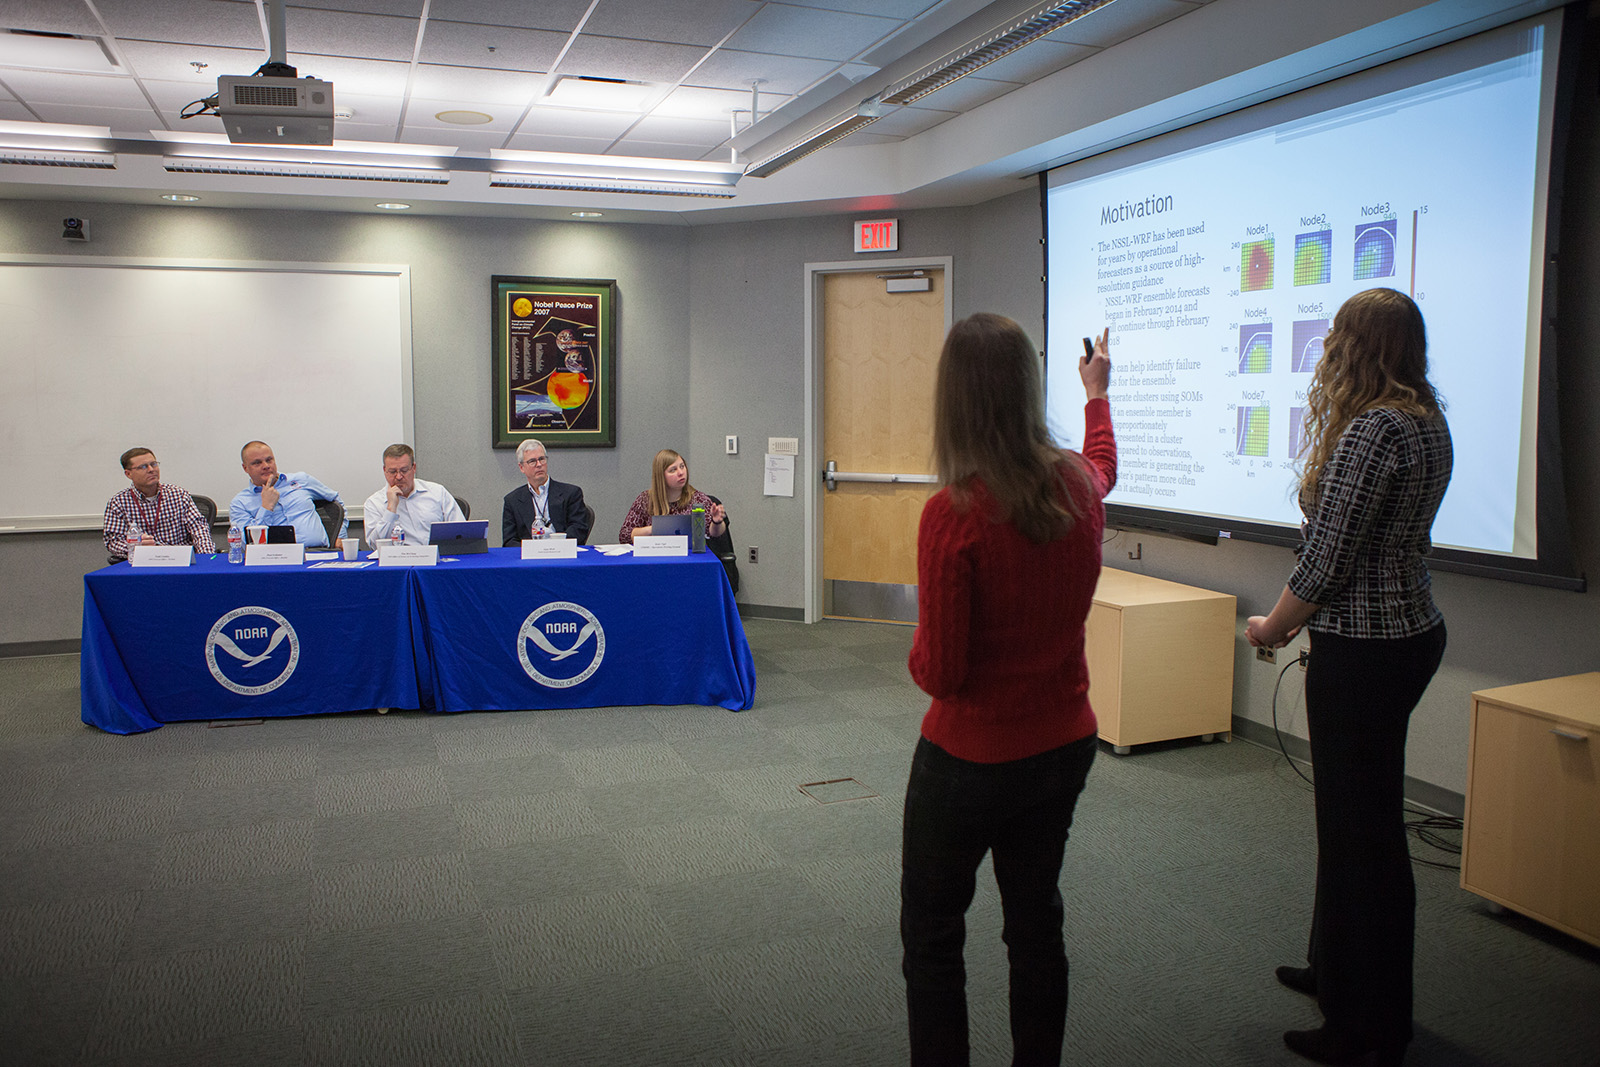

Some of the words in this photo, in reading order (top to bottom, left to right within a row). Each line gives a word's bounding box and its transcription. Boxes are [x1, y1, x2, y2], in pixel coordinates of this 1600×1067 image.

[1101, 194, 1173, 226] Motivation
[1361, 202, 1390, 216] Node3
[1420, 205, 1428, 214] 15
[1300, 214, 1326, 227] Node2
[861, 222, 892, 249] EXIT
[1098, 241, 1110, 252] The
[1112, 232, 1151, 250] NSSL-WRF
[1153, 231, 1166, 242] has
[1167, 228, 1185, 239] been
[1186, 221, 1205, 235] used
[1246, 224, 1268, 236] Node1
[1098, 255, 1107, 266] for
[1108, 254, 1126, 267] years
[1127, 250, 1136, 263] by
[1137, 241, 1178, 261] operational
[1098, 266, 1133, 280] forecasters
[1135, 265, 1142, 273] as
[1149, 261, 1173, 271] source
[1175, 255, 1183, 267] of
[1184, 252, 1205, 268] high-
[1097, 280, 1130, 294] resolution
[1132, 276, 1164, 291] guidance
[1105, 293, 1142, 307] NSSL-WRF
[1143, 288, 1176, 302] ensemble
[1177, 285, 1210, 299] forecasts
[1416, 292, 1424, 300] 10
[534, 301, 554, 309] Nobel
[1105, 309, 1123, 321] began
[1125, 308, 1132, 318] in
[1133, 305, 1164, 317] February
[1165, 304, 1182, 314] 2014
[1184, 299, 1198, 311] and
[1298, 302, 1323, 314] Node5
[1244, 308, 1267, 318] Node4
[1118, 321, 1145, 332] continue
[1147, 318, 1174, 330] through
[1176, 315, 1210, 327] February
[1117, 364, 1128, 373] can
[1130, 361, 1145, 374] help
[1147, 359, 1175, 373] identify
[1176, 358, 1201, 370] failure
[1118, 375, 1128, 386] for
[1130, 374, 1140, 386] the
[1142, 374, 1176, 385] ensemble
[1133, 391, 1159, 402] clusters
[1160, 392, 1179, 404] using
[1181, 391, 1203, 402] SOMs
[1242, 391, 1265, 400] Node7
[1117, 409, 1124, 417] an
[1125, 407, 1155, 417] ensemble
[1156, 407, 1184, 417] member
[1186, 407, 1191, 417] is
[1147, 434, 1153, 443] in
[1155, 435, 1159, 443] a
[1160, 434, 1183, 444] cluster
[1141, 447, 1147, 455] to
[1149, 446, 1192, 459] observations,
[1123, 458, 1148, 469] member
[1150, 459, 1155, 469] is
[1156, 461, 1192, 474] generating
[1193, 462, 1204, 472] the
[1135, 473, 1157, 482] pattern
[1159, 476, 1176, 484] more
[1178, 475, 1195, 486] often
[1124, 483, 1128, 492] it
[1129, 483, 1153, 496] actually
[1155, 487, 1176, 497] occurs
[227, 611, 239, 619] AND
[235, 627, 268, 640] NOAA
[546, 622, 577, 634] NOAA
